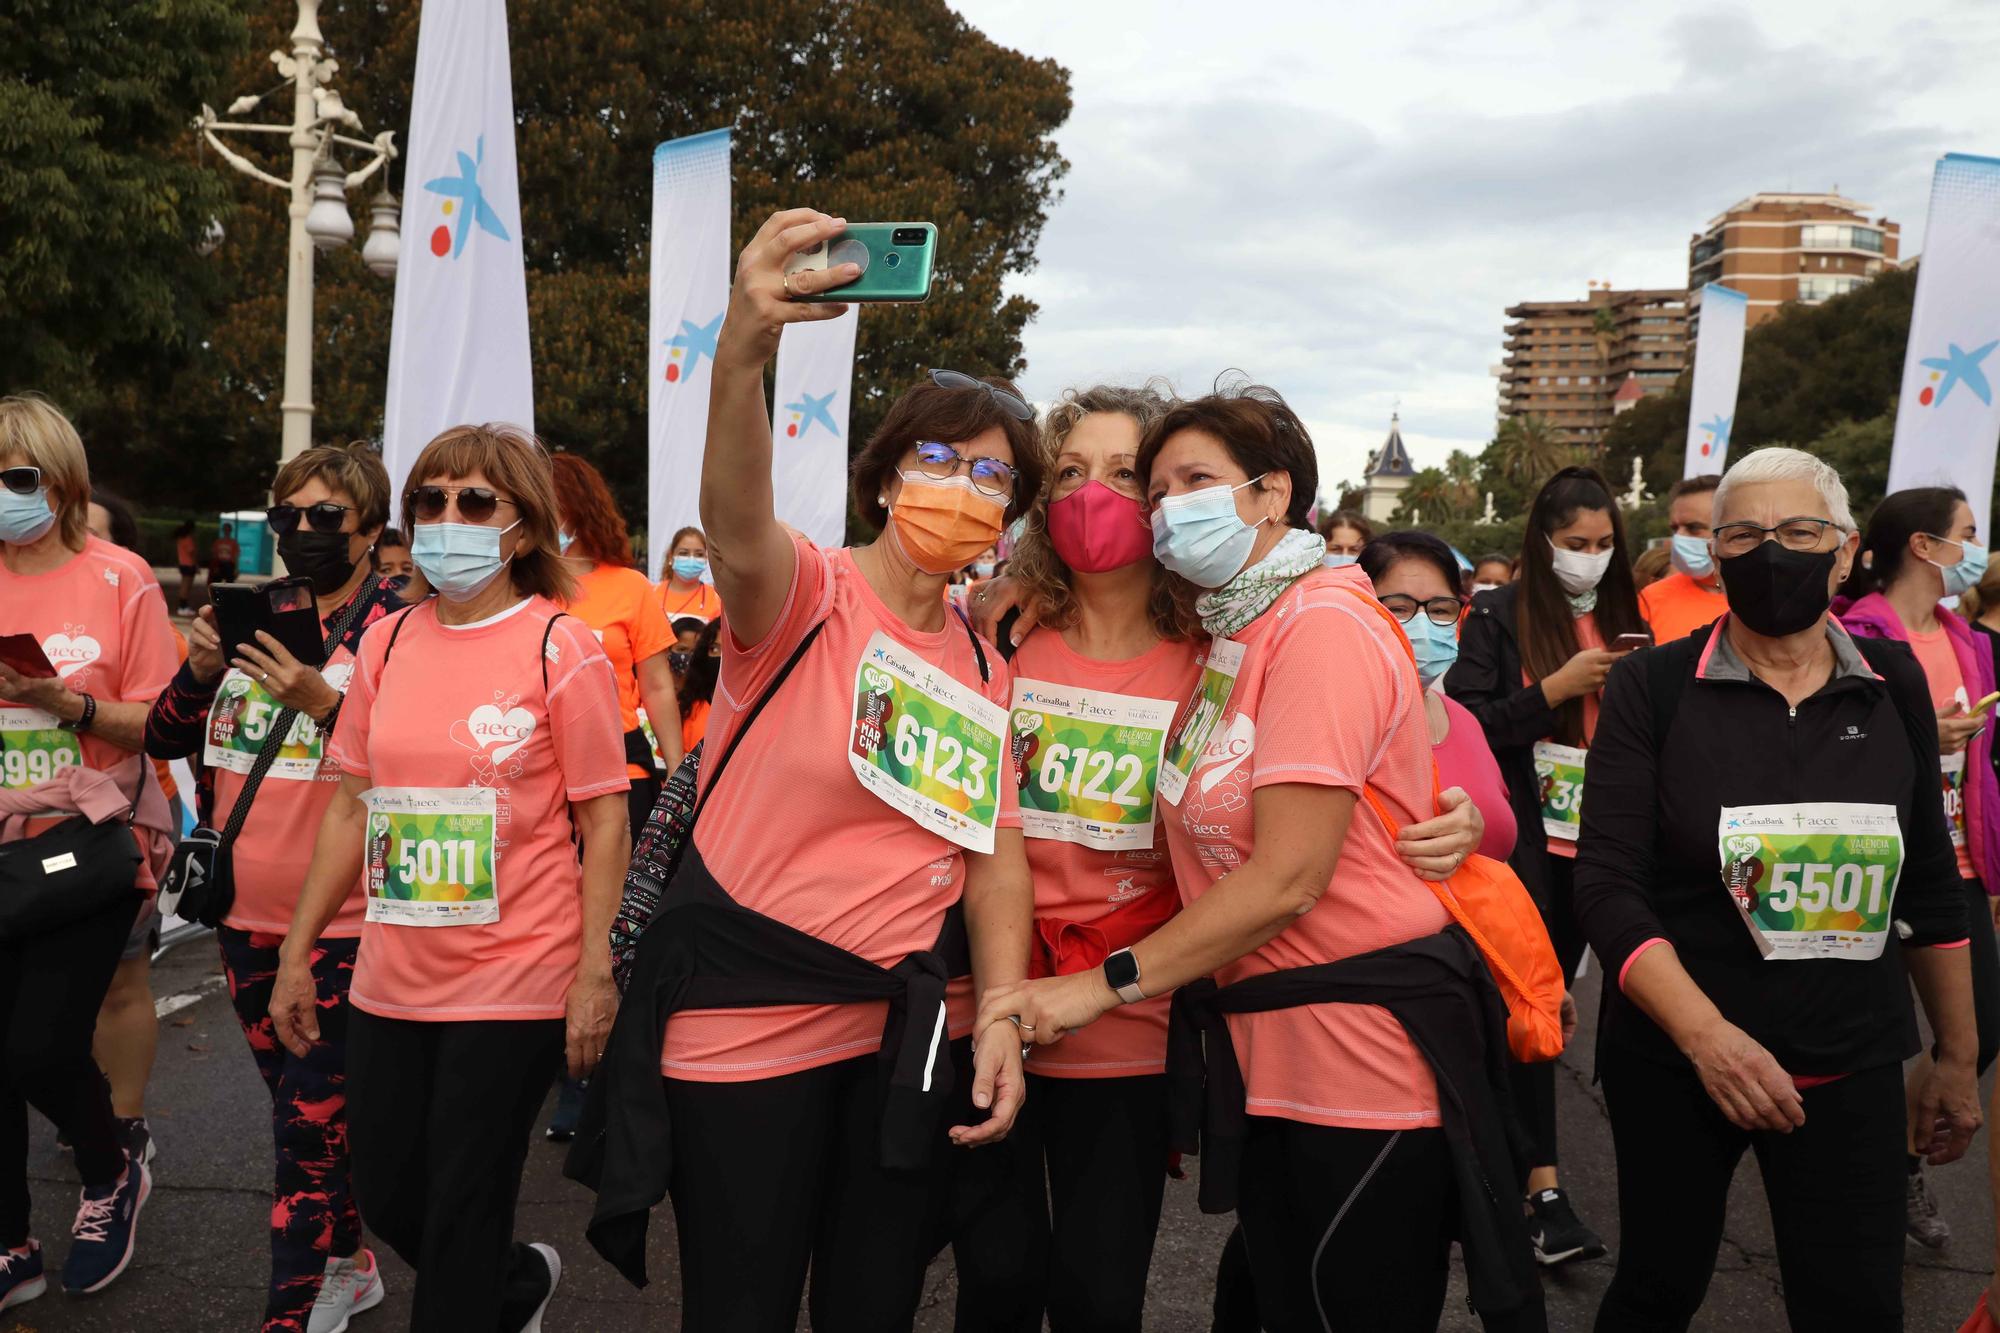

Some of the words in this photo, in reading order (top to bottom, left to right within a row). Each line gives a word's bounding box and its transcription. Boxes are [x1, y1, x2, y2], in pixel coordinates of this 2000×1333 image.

[48, 646, 94, 661] aecc
[885, 654, 917, 679] CaixaBank
[932, 684, 957, 701] aecc
[1036, 694, 1070, 707] CaixaBank
[866, 705, 876, 726] RUN
[1089, 704, 1117, 716] aecc
[215, 721, 235, 733] MAR
[244, 701, 317, 746] 589
[475, 721, 530, 739] aecc
[213, 731, 232, 743] CHA
[861, 723, 881, 743] MAR
[859, 735, 878, 755] CHA
[894, 714, 988, 800] 6123
[0, 747, 75, 786] 998
[1039, 743, 1143, 806] 6122
[1192, 824, 1231, 835] aecc
[1742, 817, 1784, 825] CaixaBank
[1807, 817, 1839, 826] aecc
[399, 838, 476, 885] 5011
[371, 868, 385, 879] MAR
[371, 879, 385, 889] CHA
[1769, 863, 1885, 914] 5501
